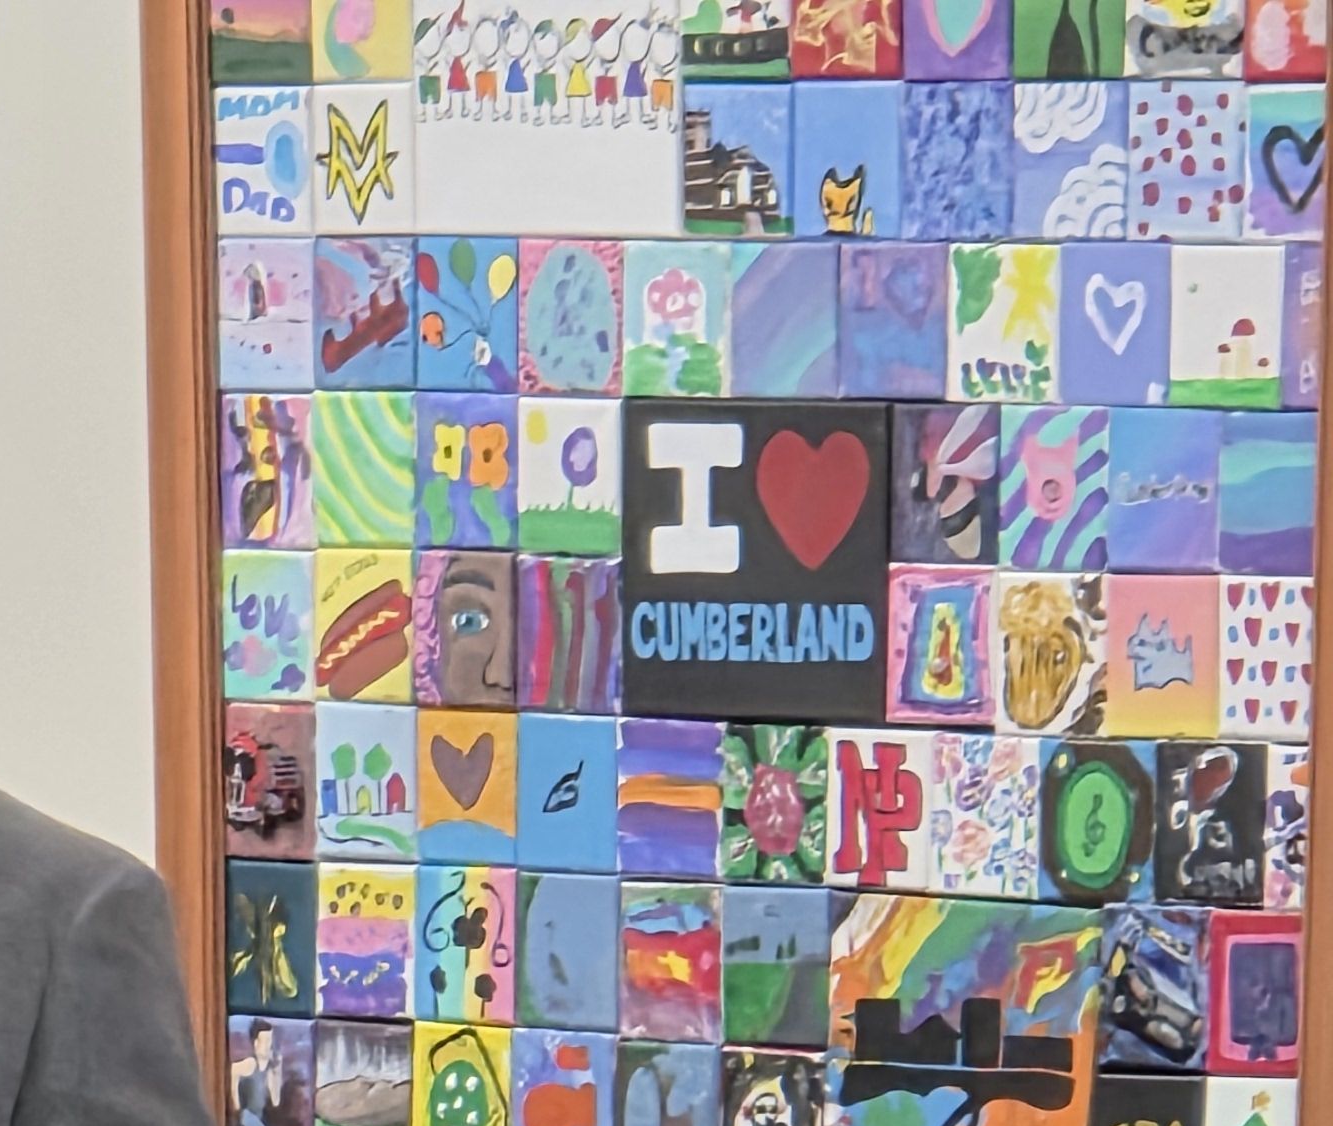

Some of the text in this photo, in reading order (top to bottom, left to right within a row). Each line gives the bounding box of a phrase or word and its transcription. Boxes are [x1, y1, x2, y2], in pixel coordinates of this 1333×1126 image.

[218, 90, 300, 121] MOM
[648, 423, 743, 574] I
[631, 601, 875, 663] CUMBERLAND
